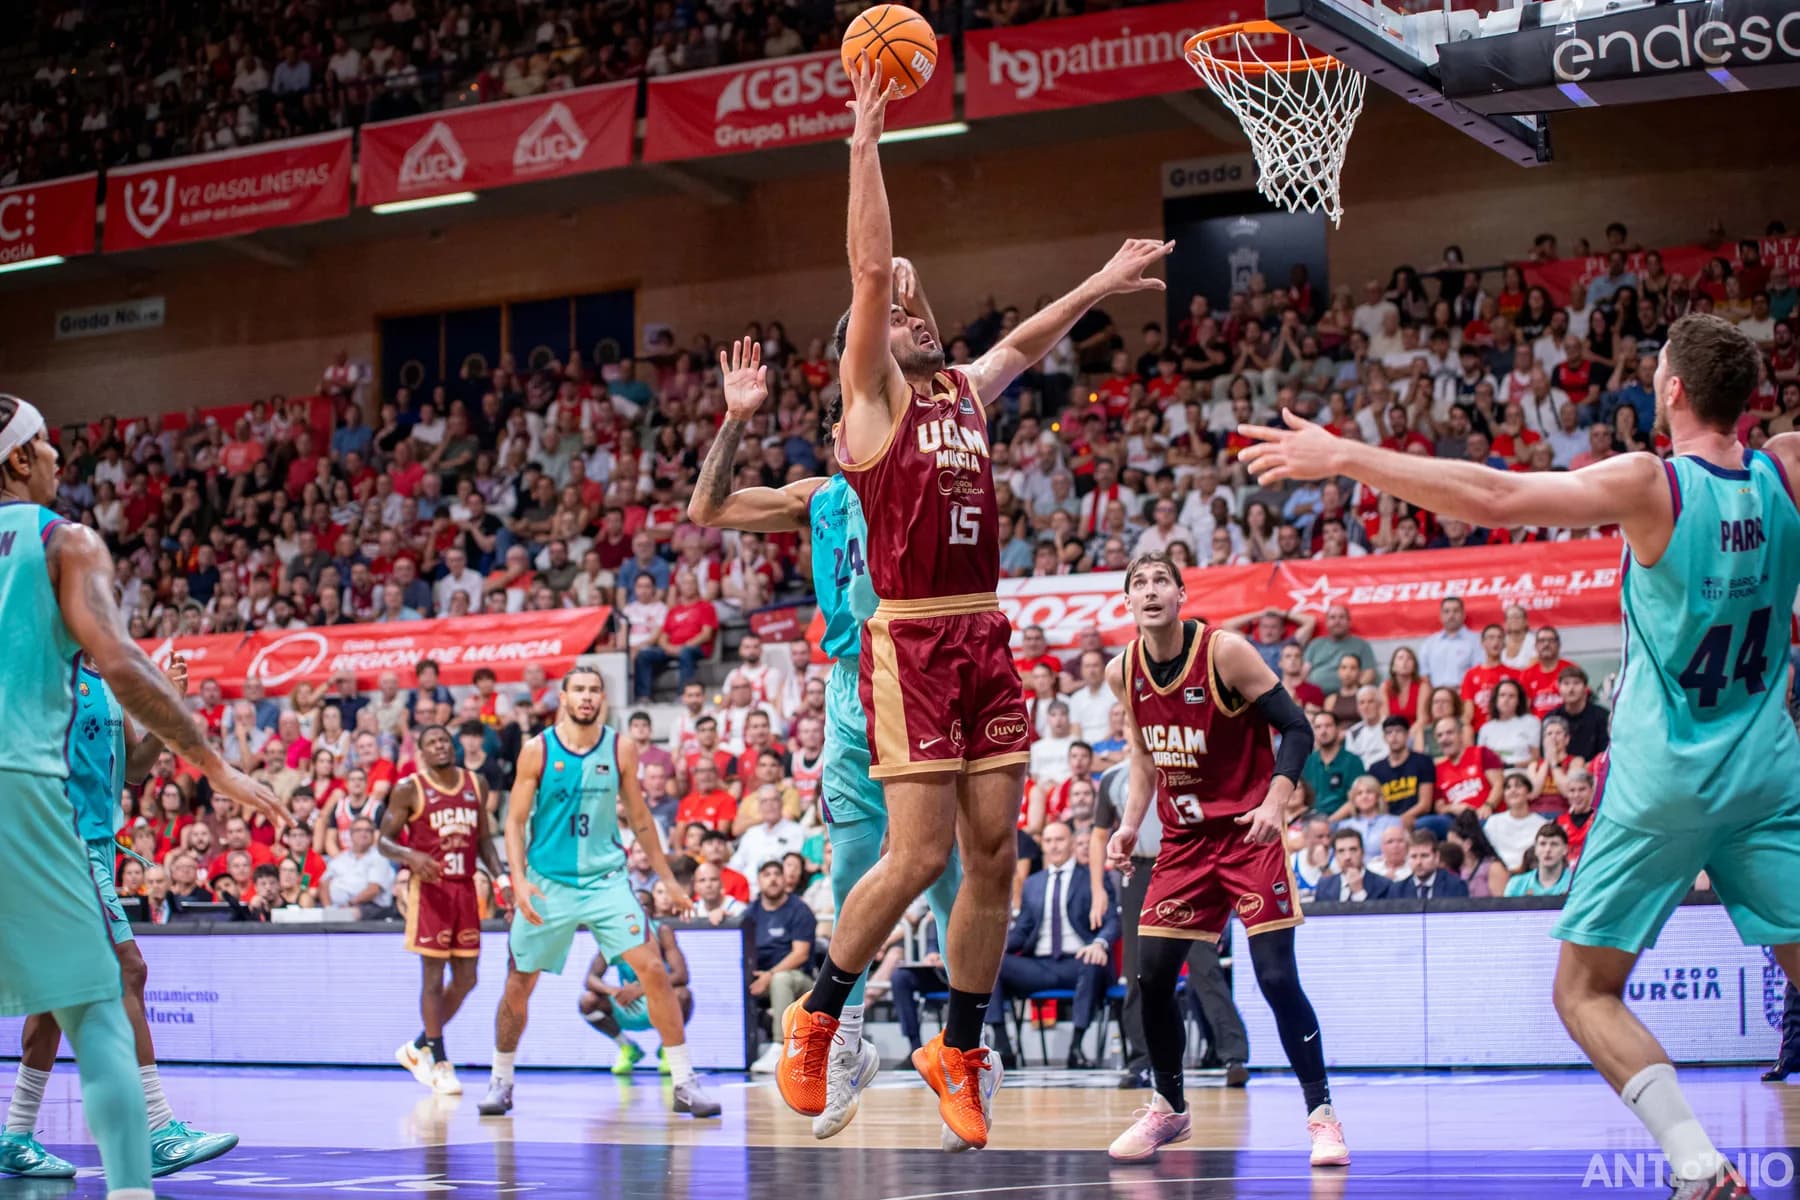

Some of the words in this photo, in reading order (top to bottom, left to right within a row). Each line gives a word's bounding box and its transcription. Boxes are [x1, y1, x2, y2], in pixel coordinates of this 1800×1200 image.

[715, 122, 785, 148] Grupo
[203, 163, 330, 204] GASOLINERAS
[1170, 163, 1242, 187] Grada
[948, 505, 982, 546] 15
[833, 537, 865, 588] 24
[1350, 572, 1535, 605] ESTRELLA
[462, 638, 563, 663] MURCIA
[1679, 606, 1773, 708] 44
[991, 722, 1026, 737] Juver
[1141, 724, 1208, 754] UCAM
[429, 807, 478, 829] UCAM
[1170, 793, 1205, 825] 13
[570, 813, 590, 838] 13
[443, 851, 465, 876] 31
[1664, 967, 1719, 981] 1200
